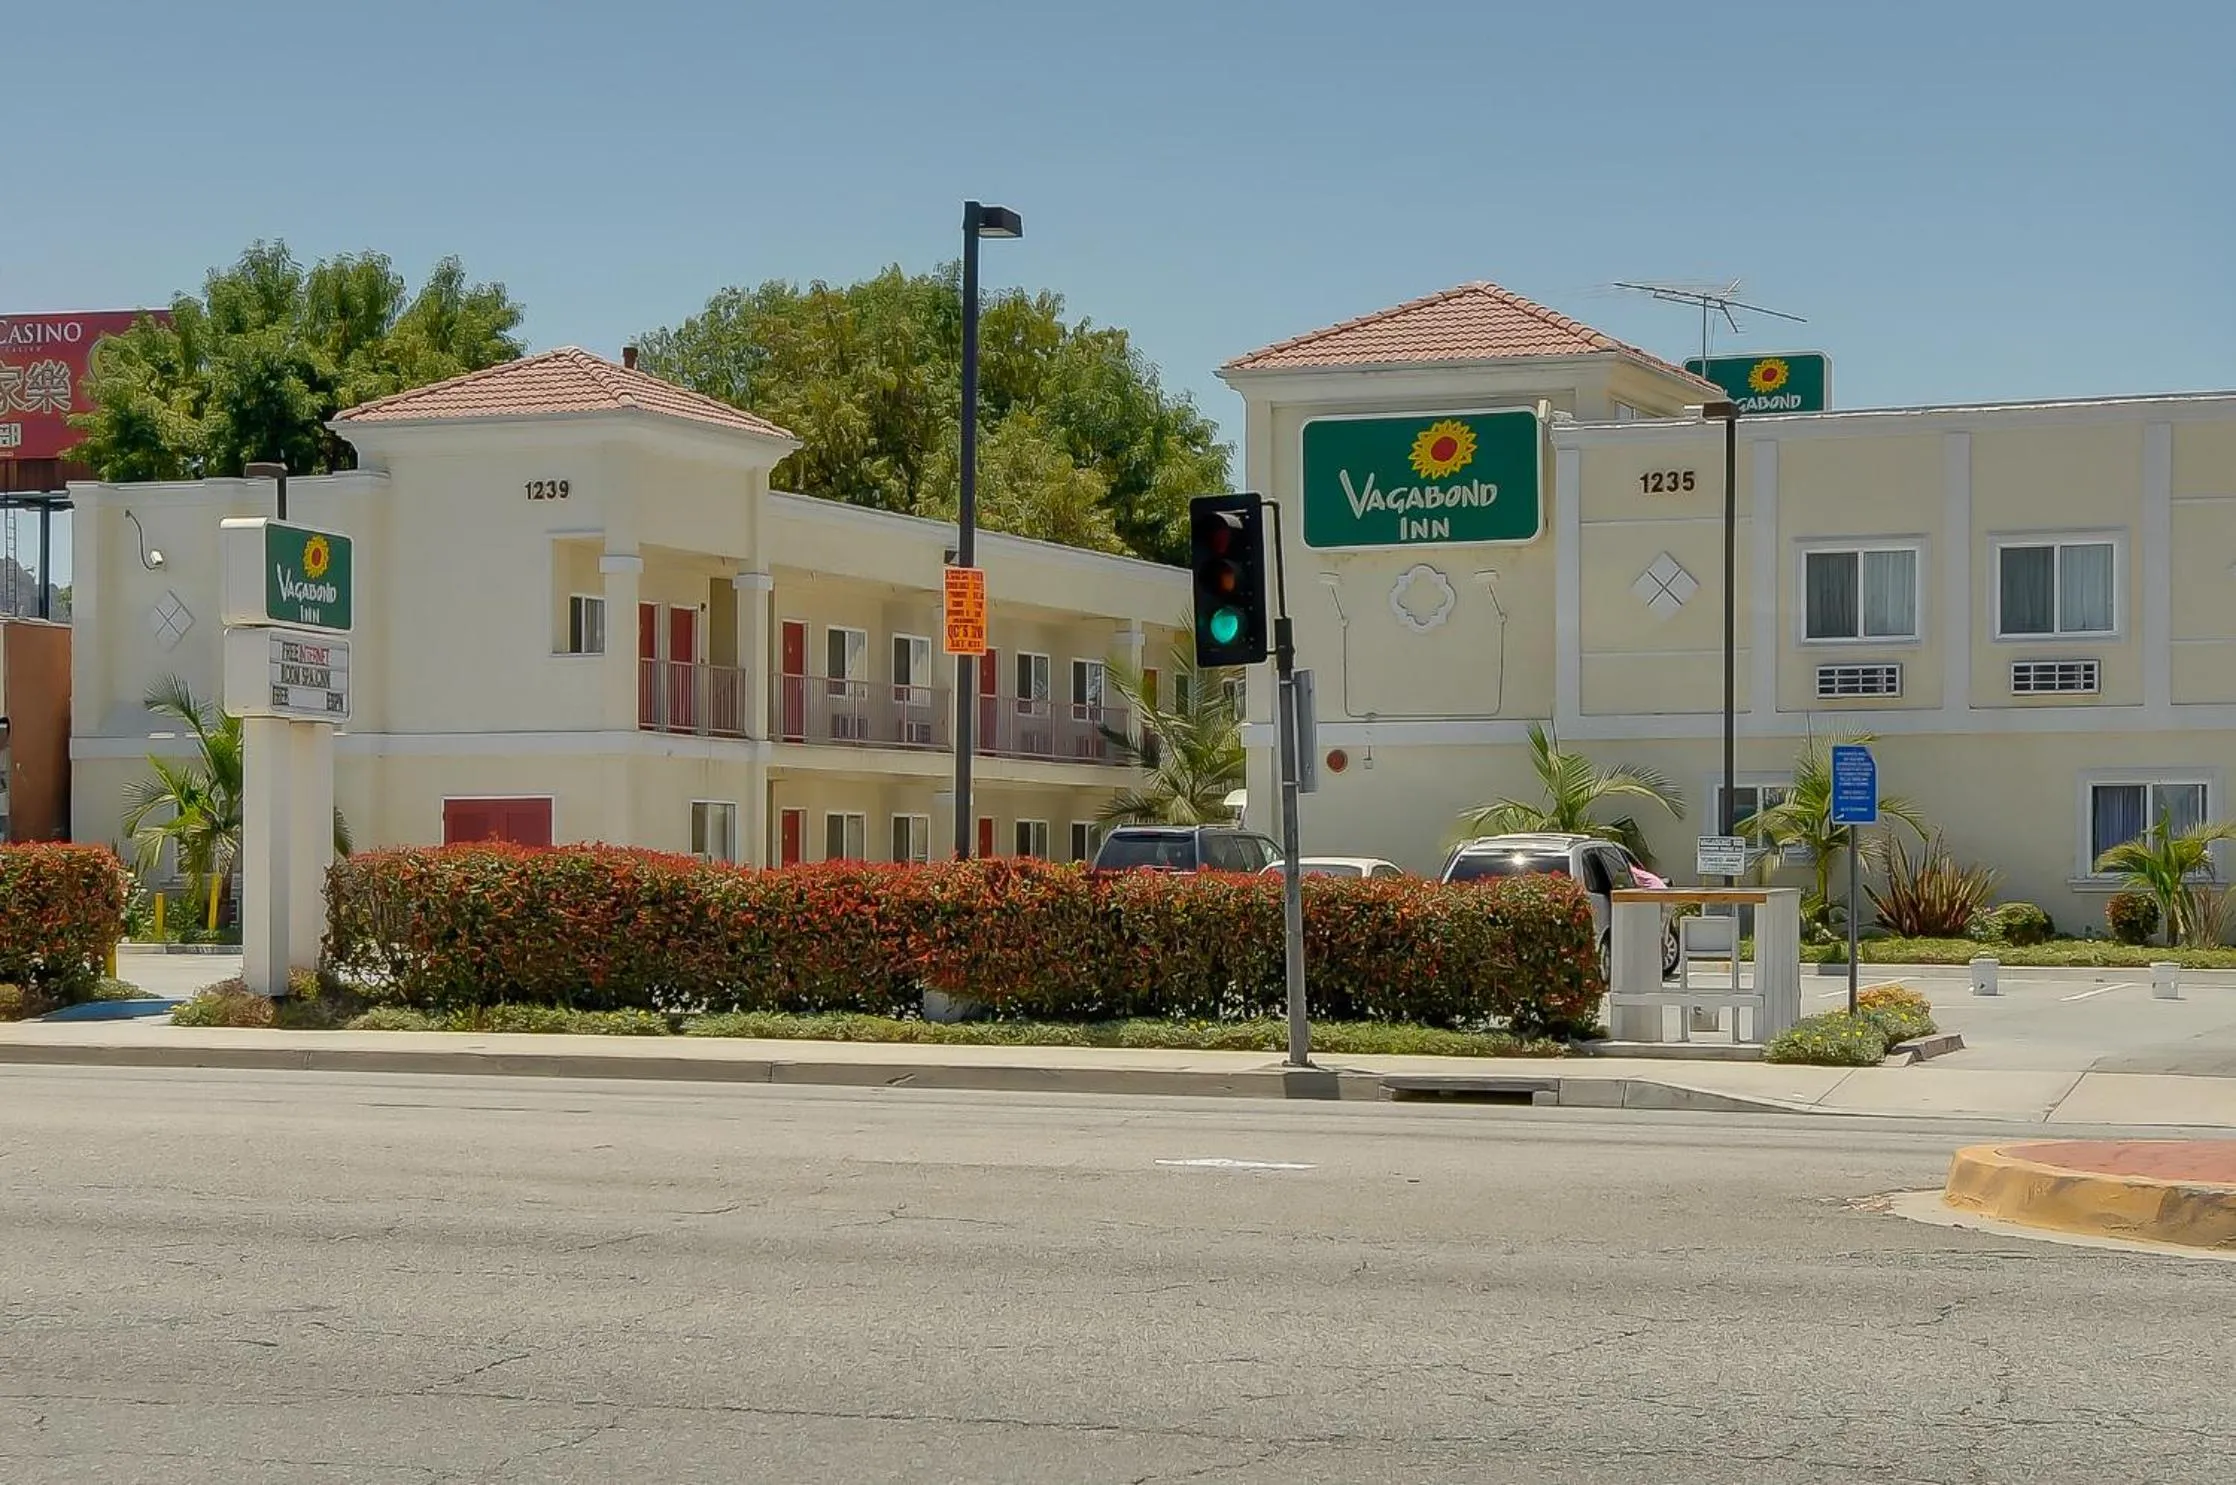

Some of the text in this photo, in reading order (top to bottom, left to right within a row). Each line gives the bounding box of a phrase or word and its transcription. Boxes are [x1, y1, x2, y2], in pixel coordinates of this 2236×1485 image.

[524, 480, 569, 500] 1239
[1639, 470, 1695, 493] 1235
[1339, 469, 1498, 520] VAGABOND
[1400, 516, 1450, 541] INN
[276, 562, 337, 604] VAGABOND
[300, 604, 320, 624] INN
